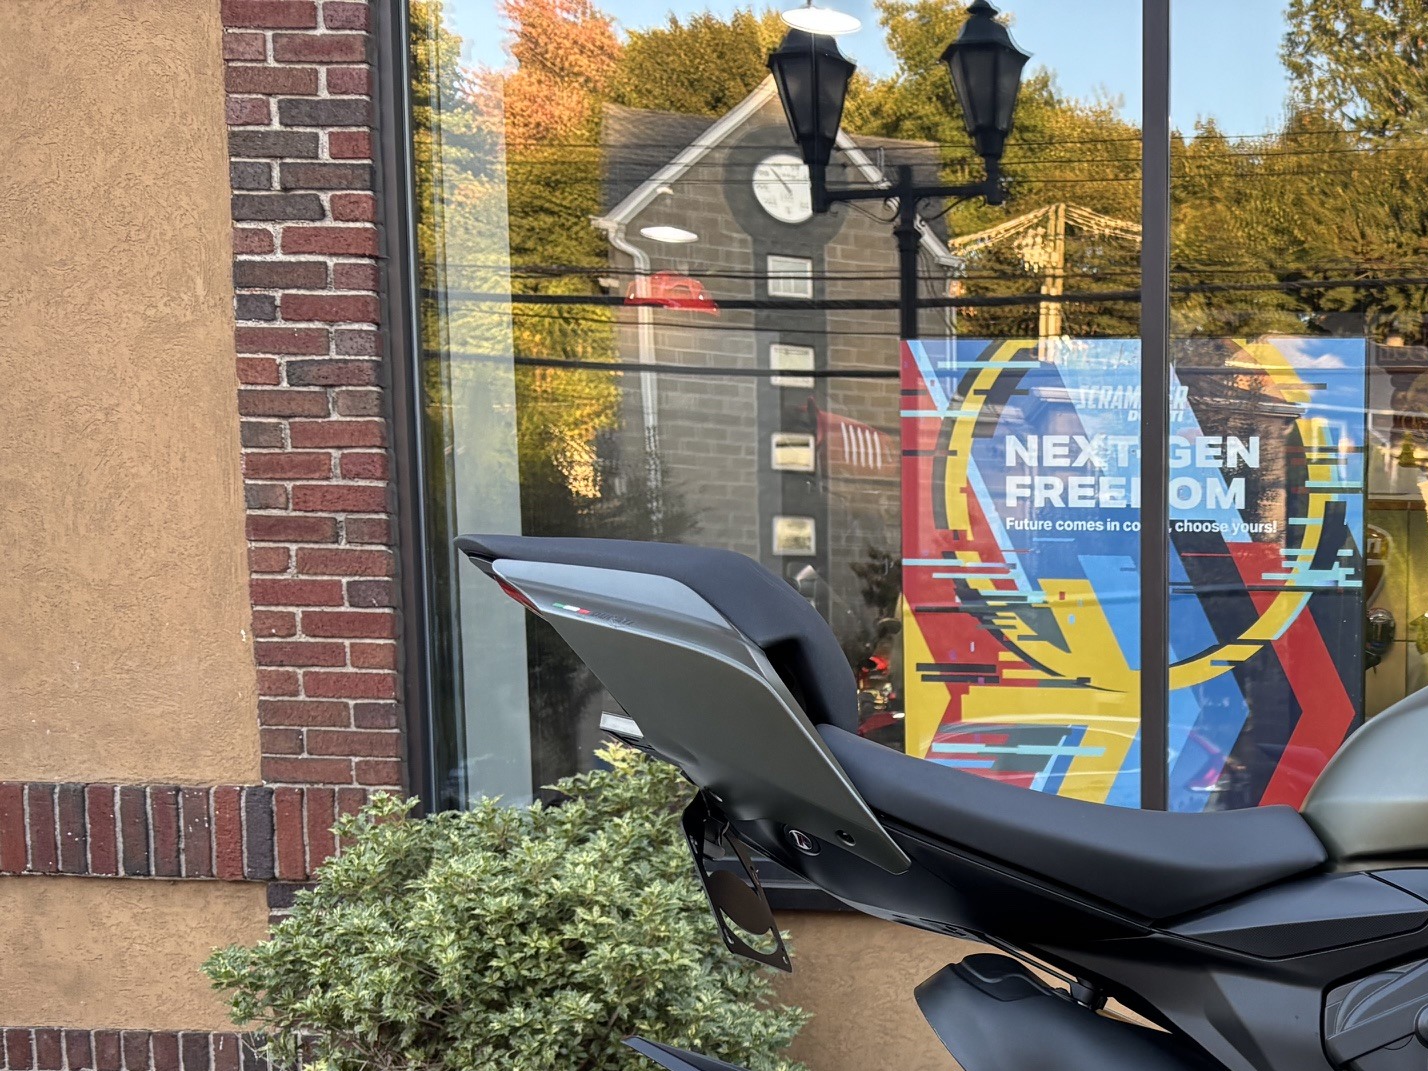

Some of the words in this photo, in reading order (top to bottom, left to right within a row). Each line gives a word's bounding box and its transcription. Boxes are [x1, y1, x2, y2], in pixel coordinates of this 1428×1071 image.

[1077, 385, 1189, 409] SCRAMR
[1006, 517, 1052, 531] Future
[1055, 520, 1104, 532] comes
[1107, 518, 1120, 532] in
[1175, 518, 1229, 533] choose
[1232, 520, 1278, 535] yours!
